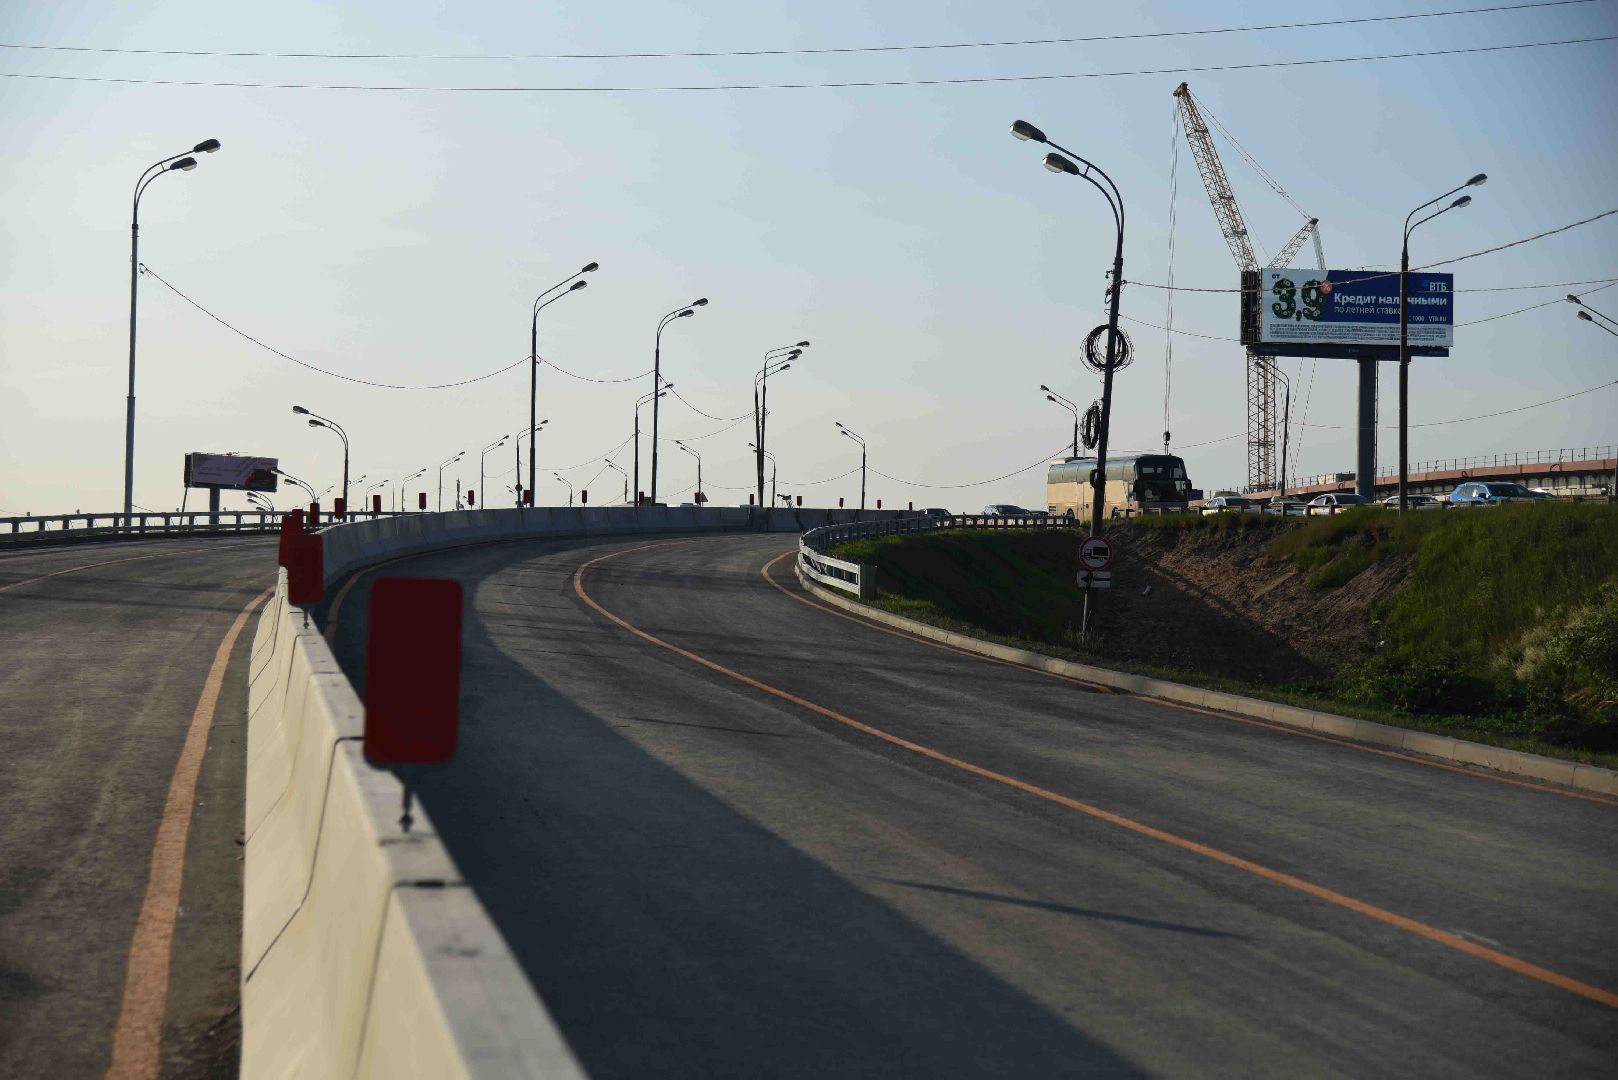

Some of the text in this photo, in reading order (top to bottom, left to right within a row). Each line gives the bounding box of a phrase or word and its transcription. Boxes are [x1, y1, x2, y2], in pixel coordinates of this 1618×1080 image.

[1429, 281, 1447, 291] ВТБ
[1271, 278, 1325, 321] 3,9
[1333, 292, 1447, 305] Кредит налчными
[1346, 305, 1375, 314] летней
